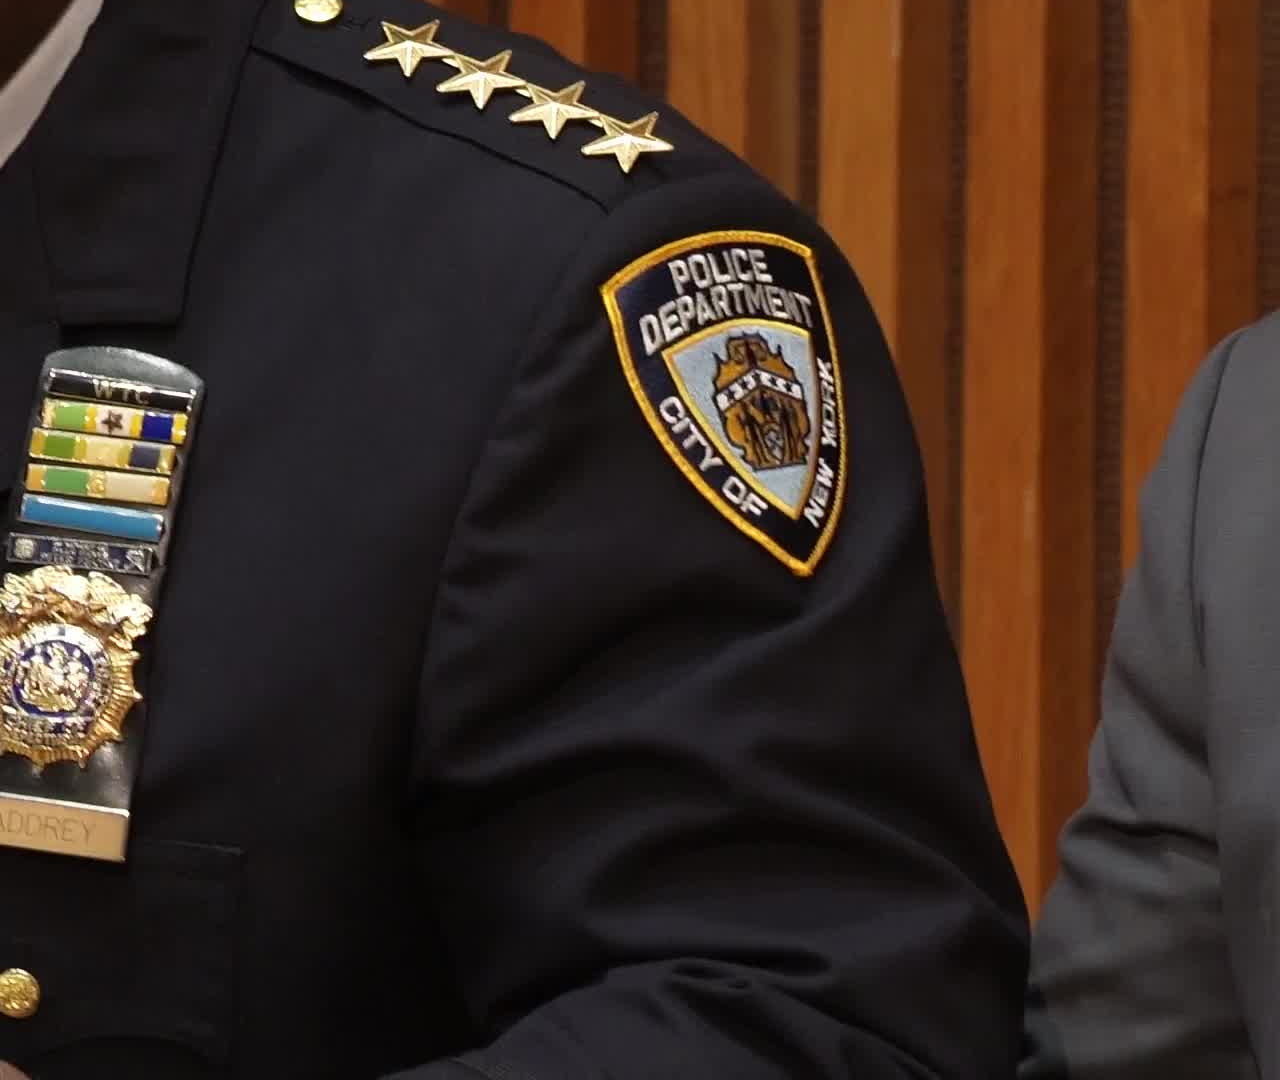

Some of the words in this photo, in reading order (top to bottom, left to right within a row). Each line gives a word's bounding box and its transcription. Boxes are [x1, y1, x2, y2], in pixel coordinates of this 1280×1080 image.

[667, 247, 774, 296] POLICE
[639, 282, 815, 357] DEPARTMENT
[92, 377, 152, 406] WTC
[658, 395, 725, 472] CITY
[721, 474, 769, 518] OF
[802, 457, 836, 529] NEW
